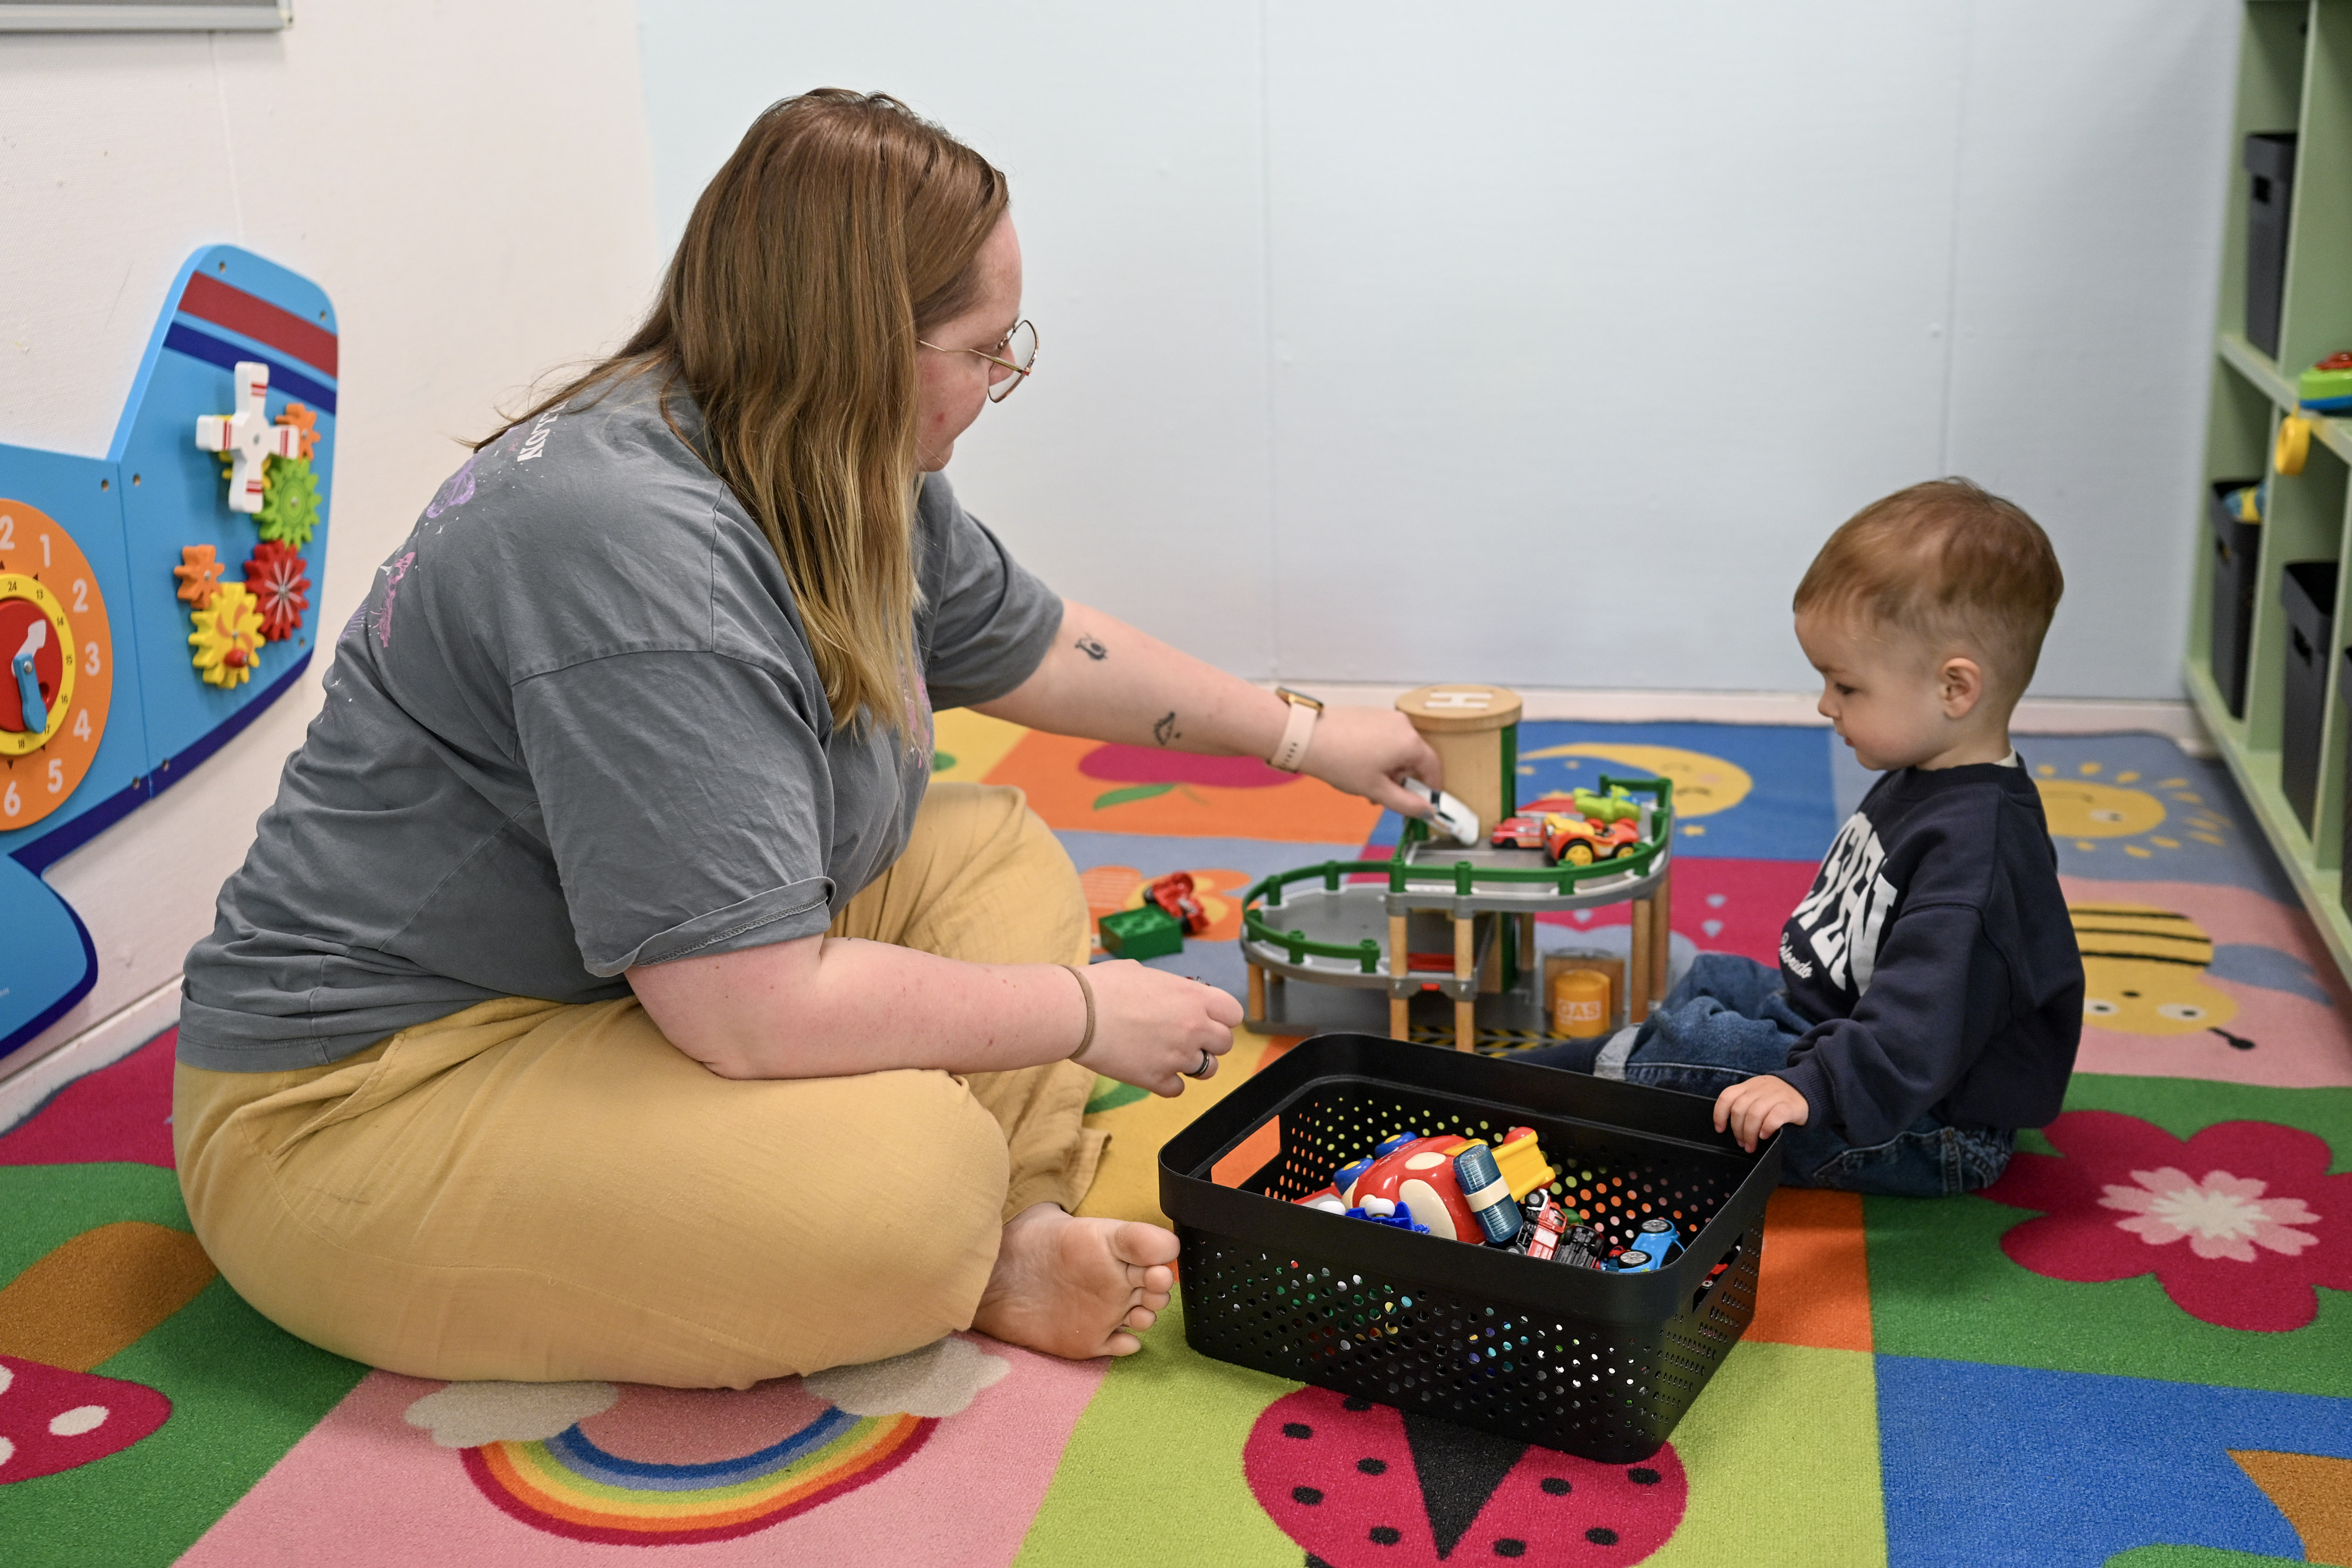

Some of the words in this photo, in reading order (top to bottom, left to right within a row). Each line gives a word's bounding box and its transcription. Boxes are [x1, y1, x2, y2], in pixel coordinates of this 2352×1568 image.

[39, 533, 51, 568] 1
[7, 580, 17, 593] 24
[72, 578, 89, 612] 2
[57, 616, 64, 627] 14
[85, 641, 101, 677] 3
[61, 694, 69, 705] 16
[72, 708, 91, 742] 4
[47, 758, 63, 793] 5
[4, 780, 21, 817] 6
